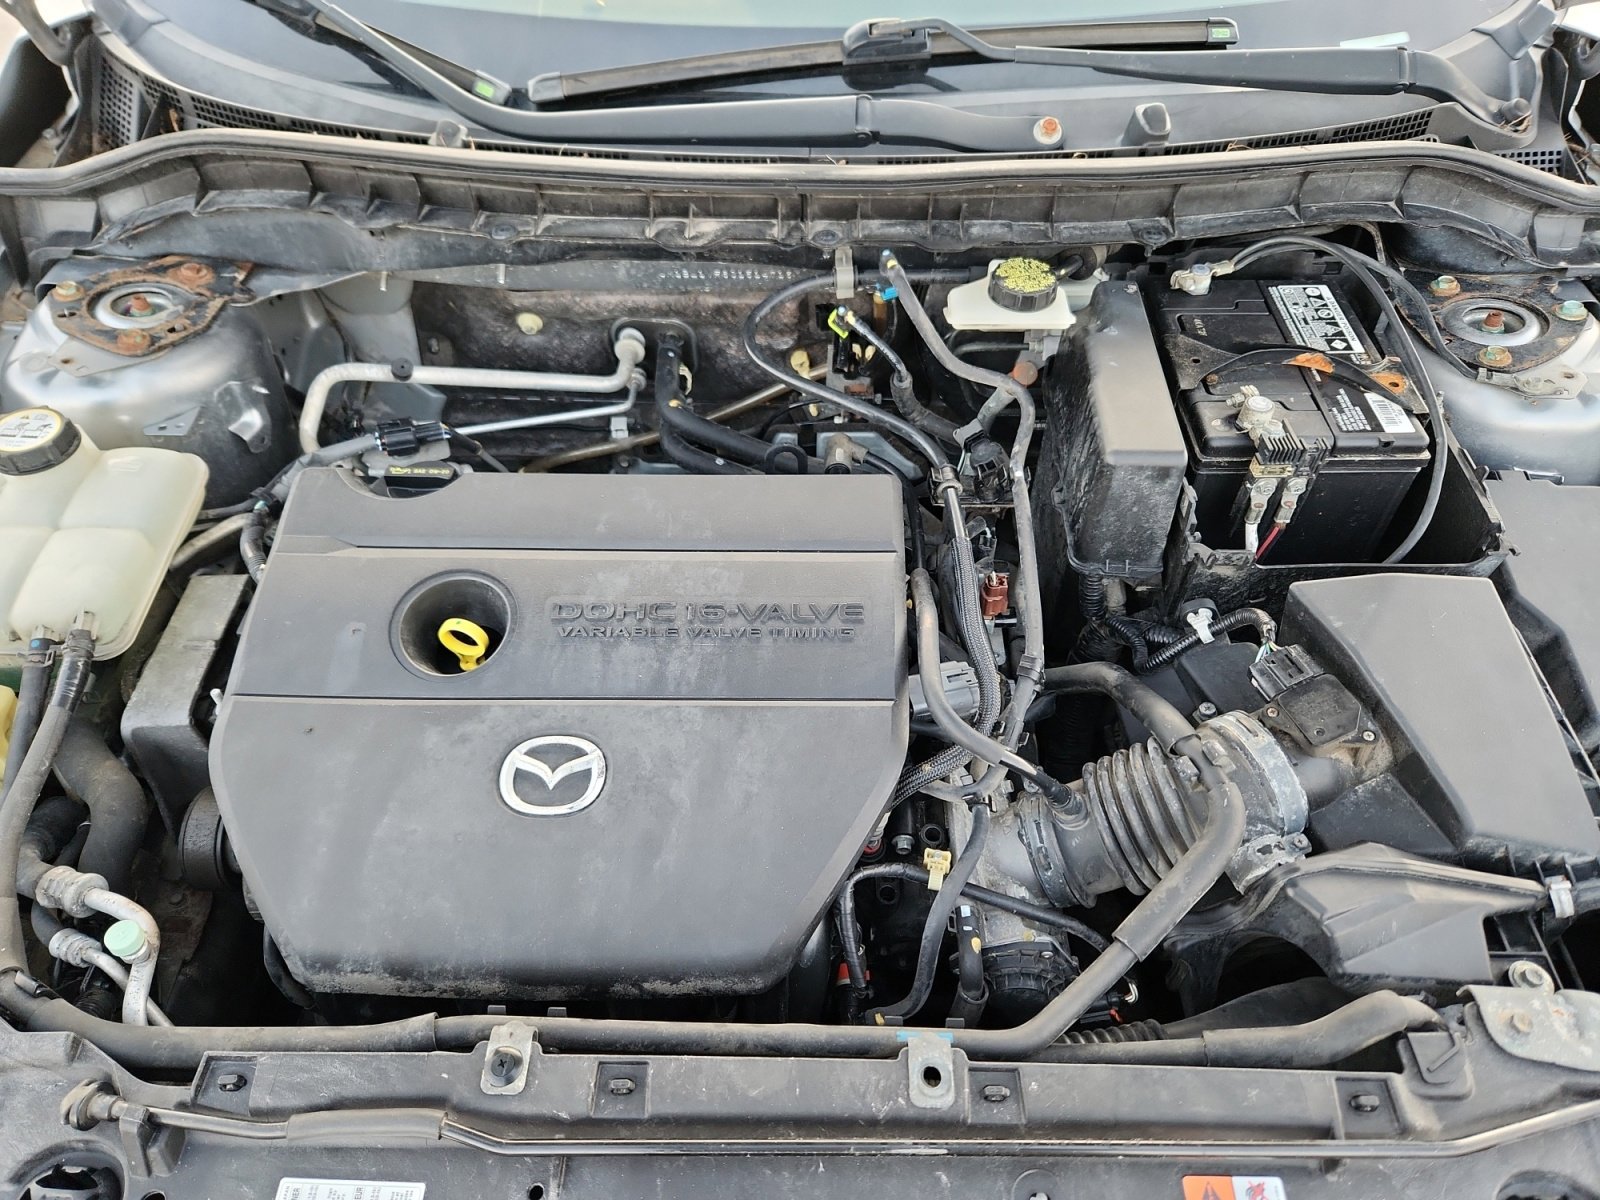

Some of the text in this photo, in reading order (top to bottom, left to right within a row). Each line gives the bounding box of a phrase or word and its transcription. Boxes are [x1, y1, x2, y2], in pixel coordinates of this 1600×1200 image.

[551, 602, 864, 623] DOHC 16-VALVE
[557, 626, 855, 640] VARIABLE VALVE TIMING
